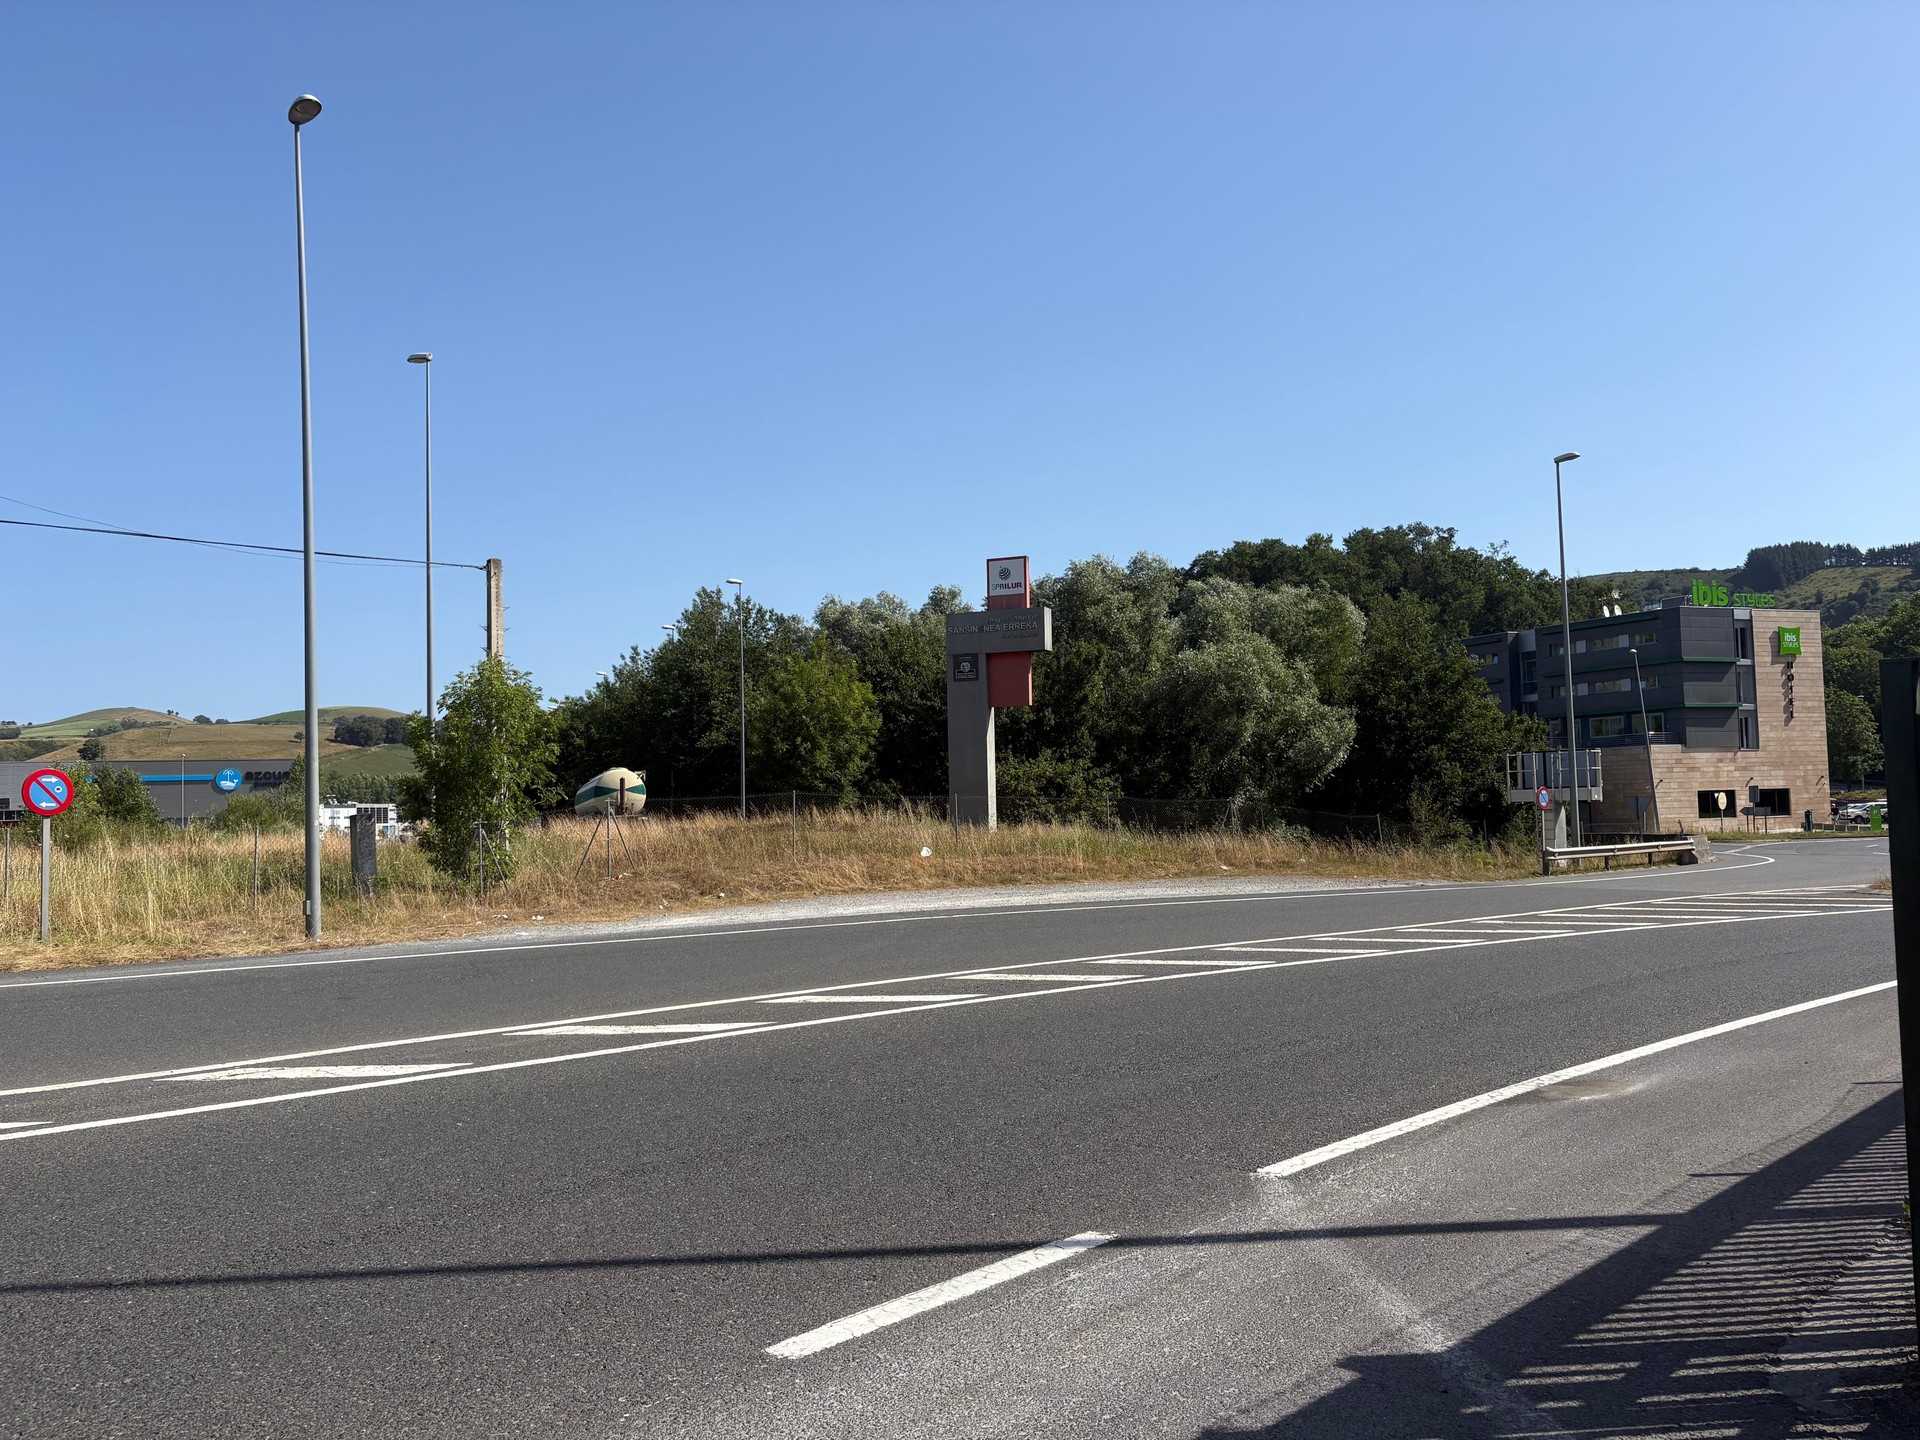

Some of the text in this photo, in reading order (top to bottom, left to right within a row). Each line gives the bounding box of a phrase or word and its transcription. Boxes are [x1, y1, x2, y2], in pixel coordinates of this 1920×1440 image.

[991, 582, 1022, 590] SPRILUR
[1692, 579, 1729, 606] ibis
[947, 621, 1038, 635] SANSINNEA ERREKA
[1784, 632, 1797, 642] ibis
[1786, 661, 1796, 718] HOTEL
[245, 771, 290, 781] azcue
